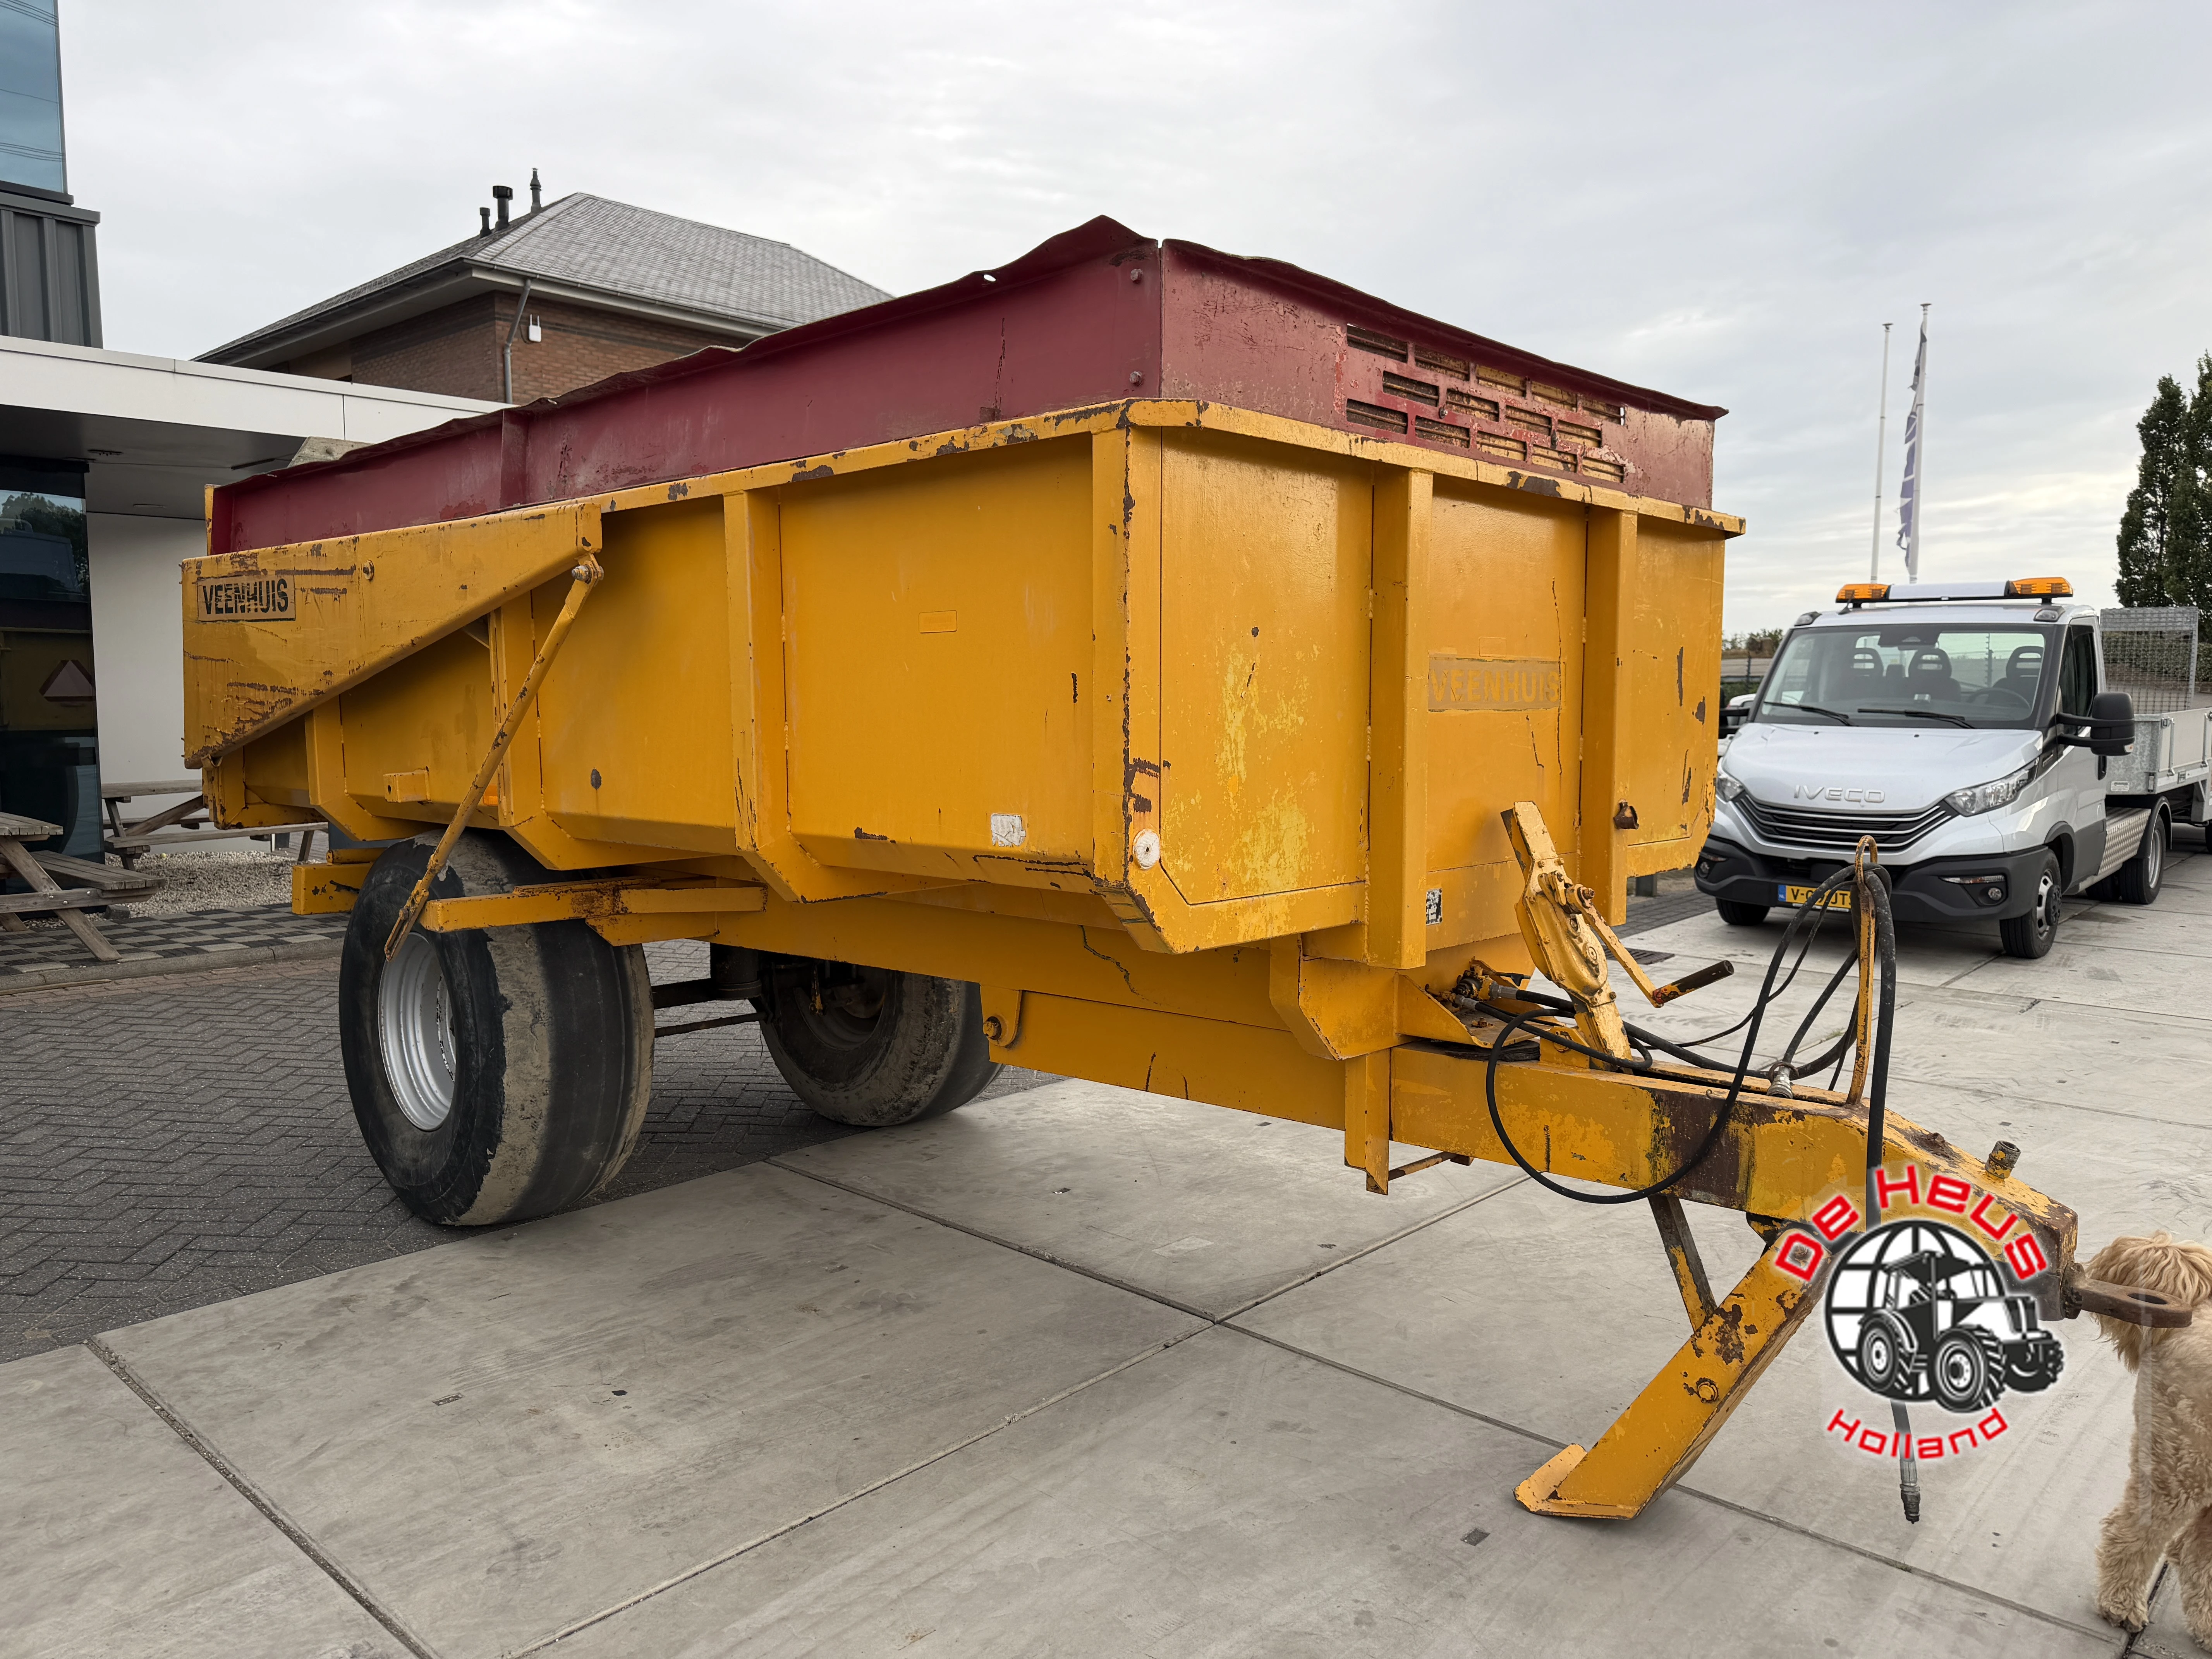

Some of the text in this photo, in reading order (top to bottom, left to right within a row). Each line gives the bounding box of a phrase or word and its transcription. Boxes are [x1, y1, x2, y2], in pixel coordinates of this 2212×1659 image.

[203, 578, 289, 615] VEENHUIS
[1432, 669, 1560, 703] VEENHUIS
[1794, 785, 1885, 803] IVECO
